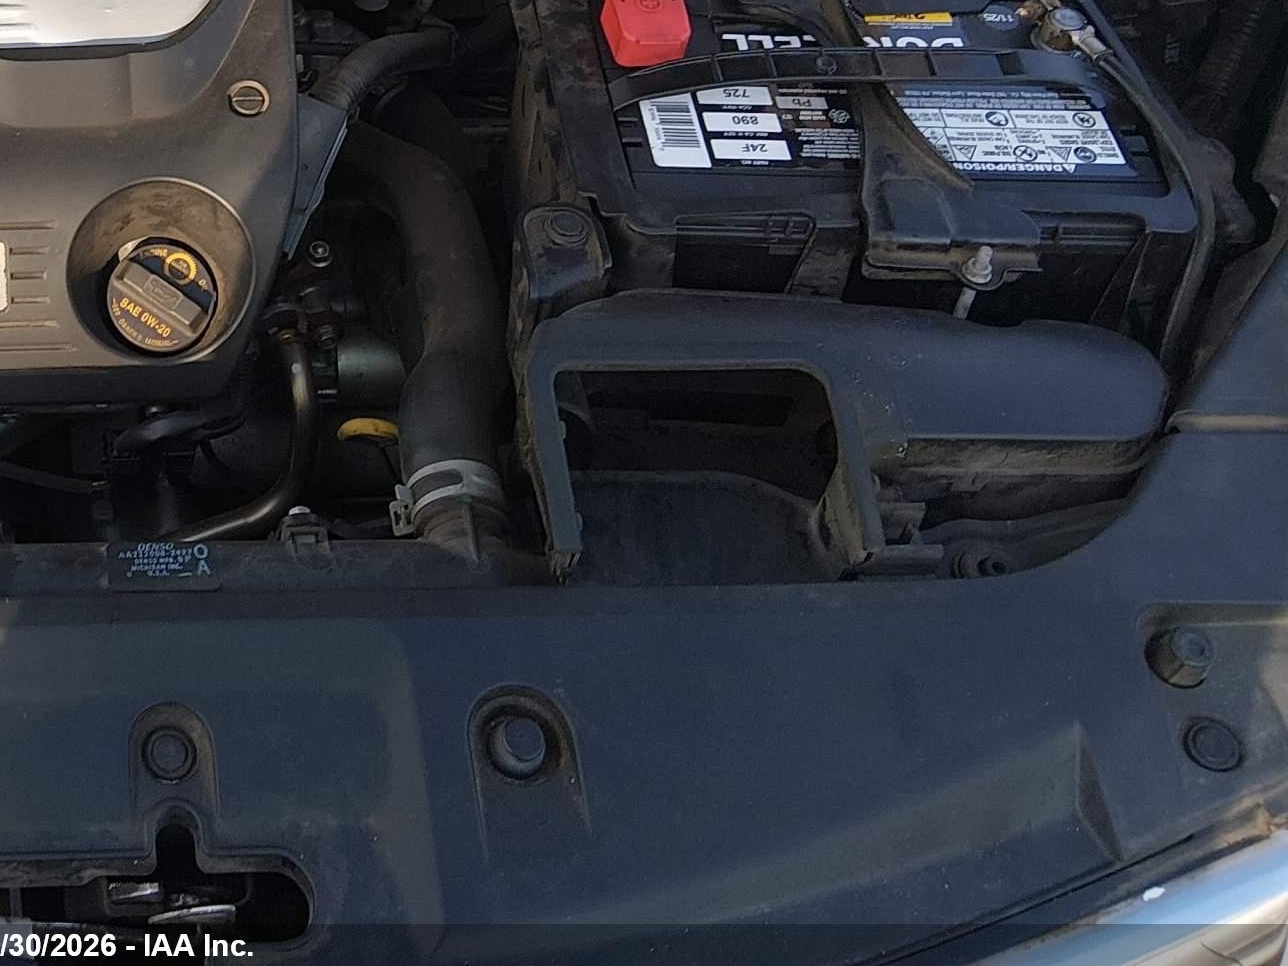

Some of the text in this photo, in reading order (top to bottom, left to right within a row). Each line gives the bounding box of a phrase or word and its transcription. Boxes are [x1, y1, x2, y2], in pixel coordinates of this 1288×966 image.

[723, 88, 750, 98] 725
[792, 97, 812, 108] Pb
[731, 115, 759, 125] 890
[741, 143, 769, 153] 24F
[119, 297, 142, 317] SAE
[141, 312, 172, 338] 0W-20
[137, 542, 175, 551] DENSO
